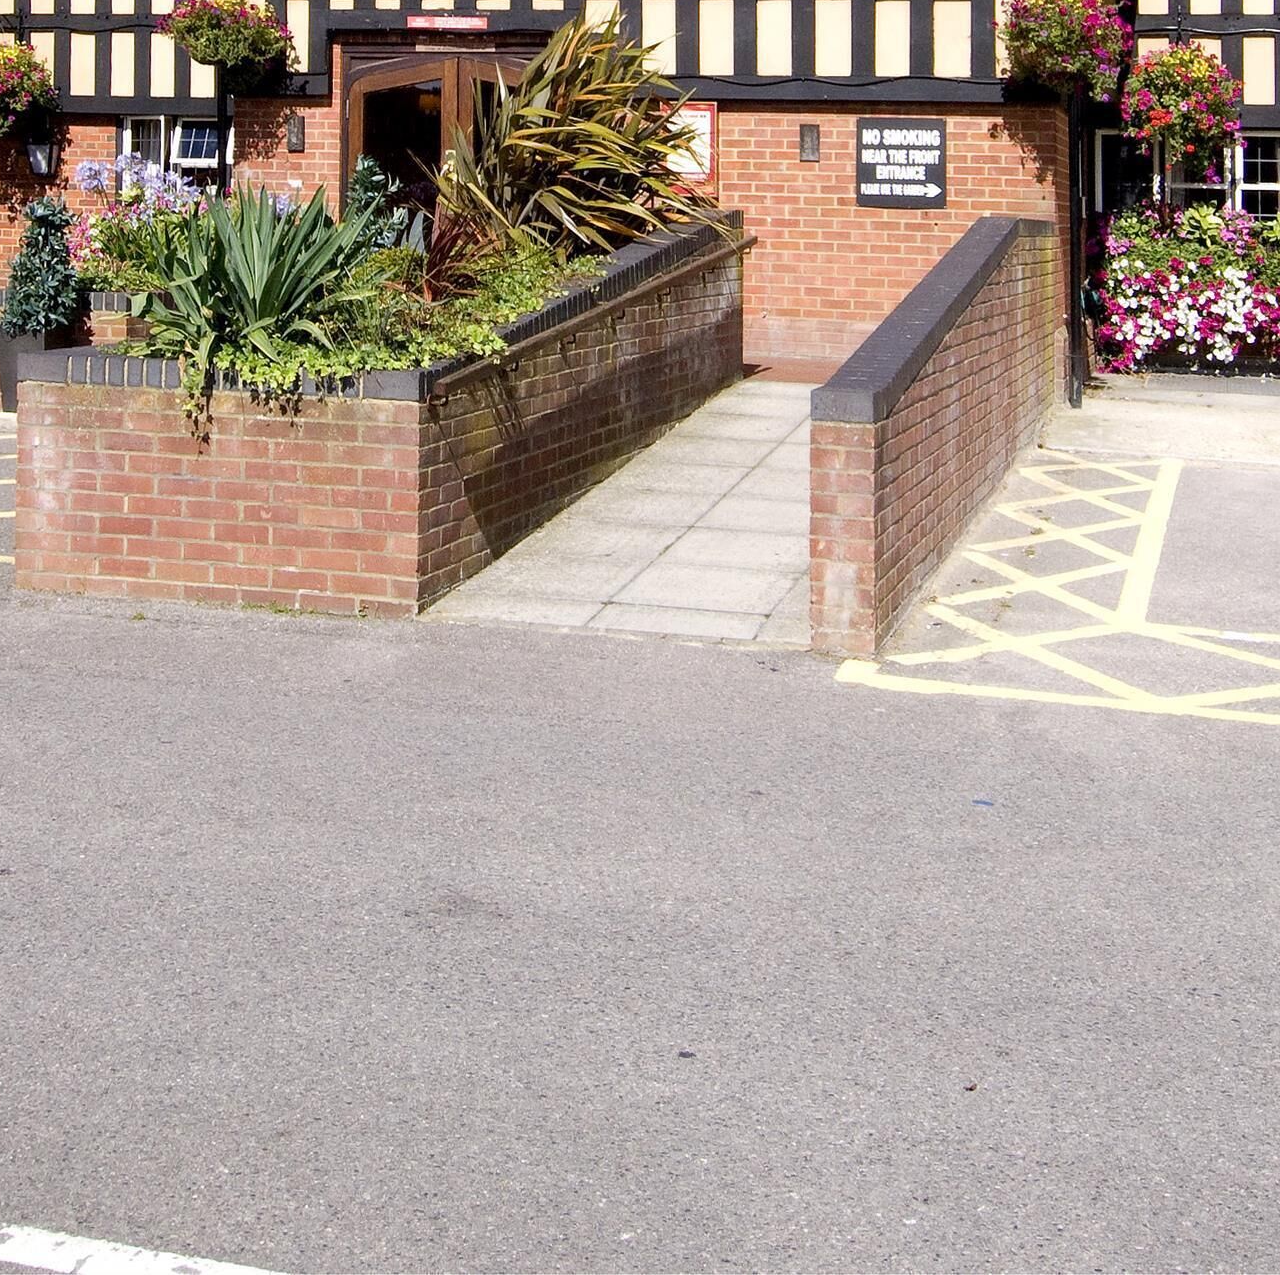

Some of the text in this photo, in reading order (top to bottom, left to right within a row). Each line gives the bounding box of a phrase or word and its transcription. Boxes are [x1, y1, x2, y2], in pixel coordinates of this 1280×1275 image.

[862, 128, 941, 146] NO SMOKING
[861, 149, 941, 165] NEAR THE FRONT
[875, 165, 926, 181] ENTRANCE
